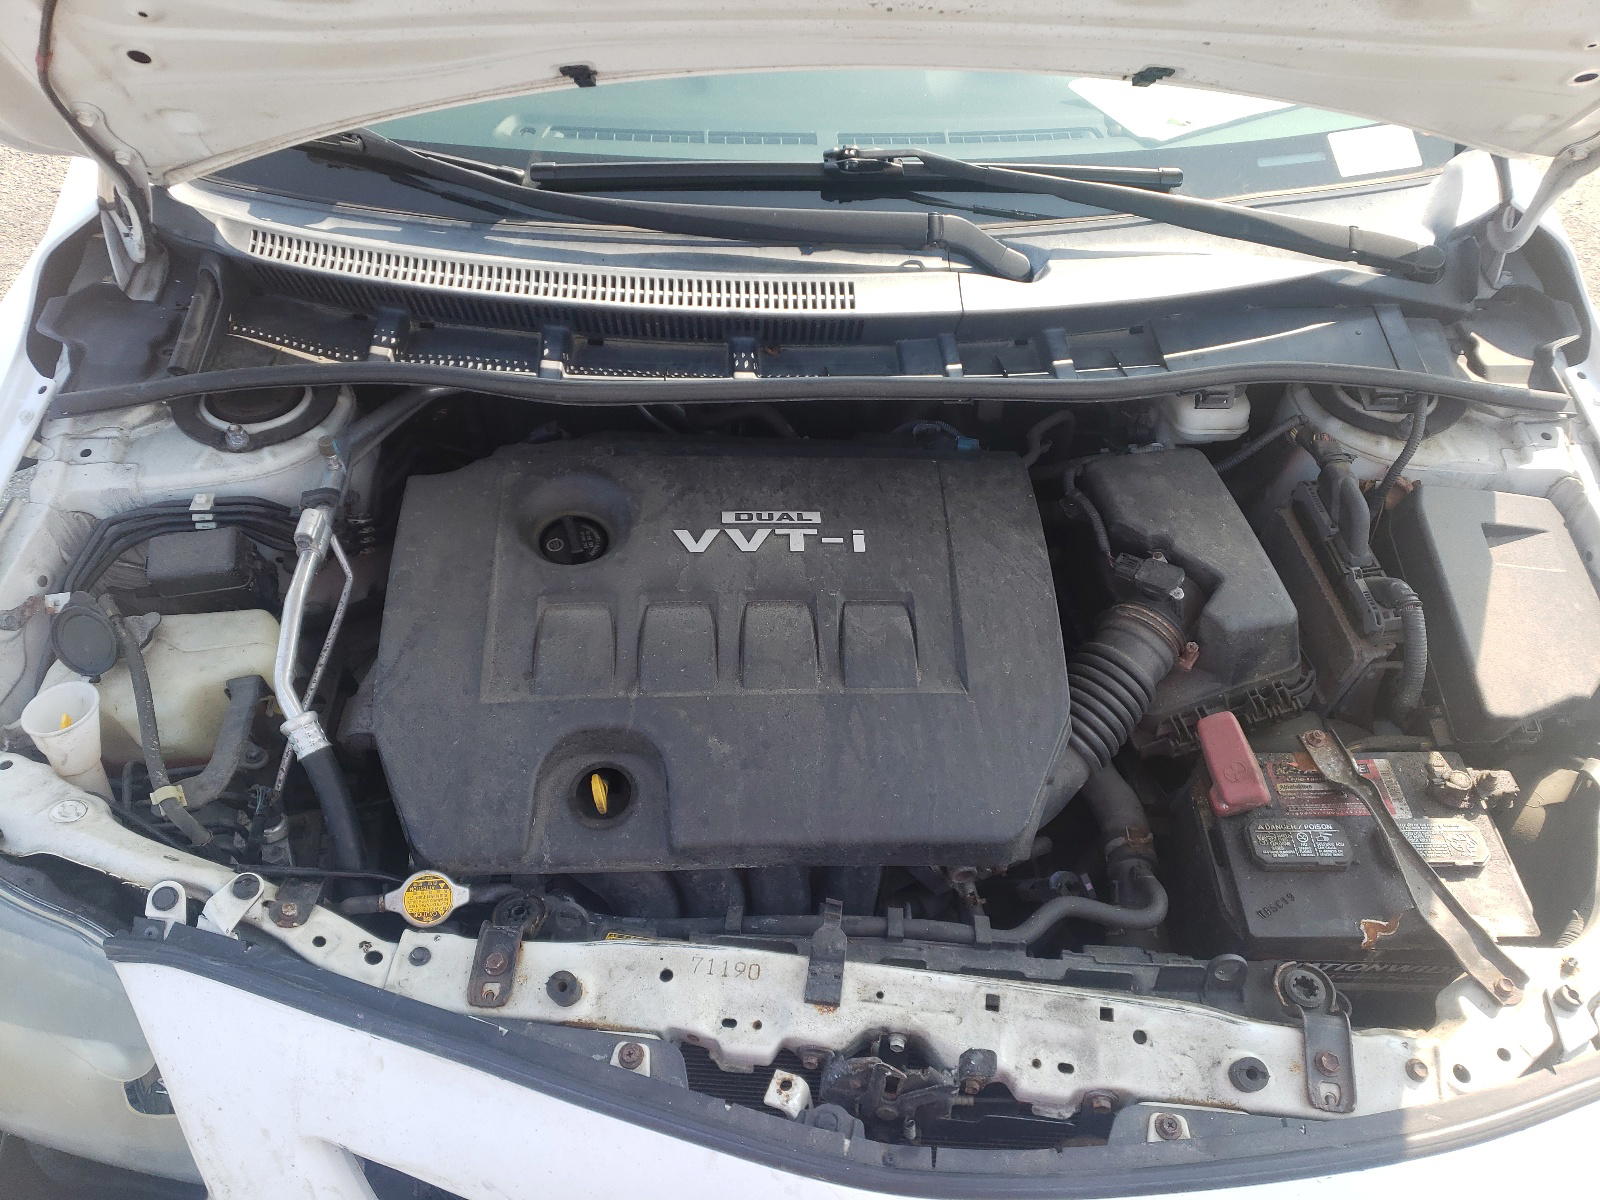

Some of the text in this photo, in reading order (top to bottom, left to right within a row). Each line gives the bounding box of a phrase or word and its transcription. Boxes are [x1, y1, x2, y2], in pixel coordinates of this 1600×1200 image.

[734, 512, 813, 522] DUAL
[673, 528, 866, 553] VVT-i
[691, 956, 761, 981] 71190
